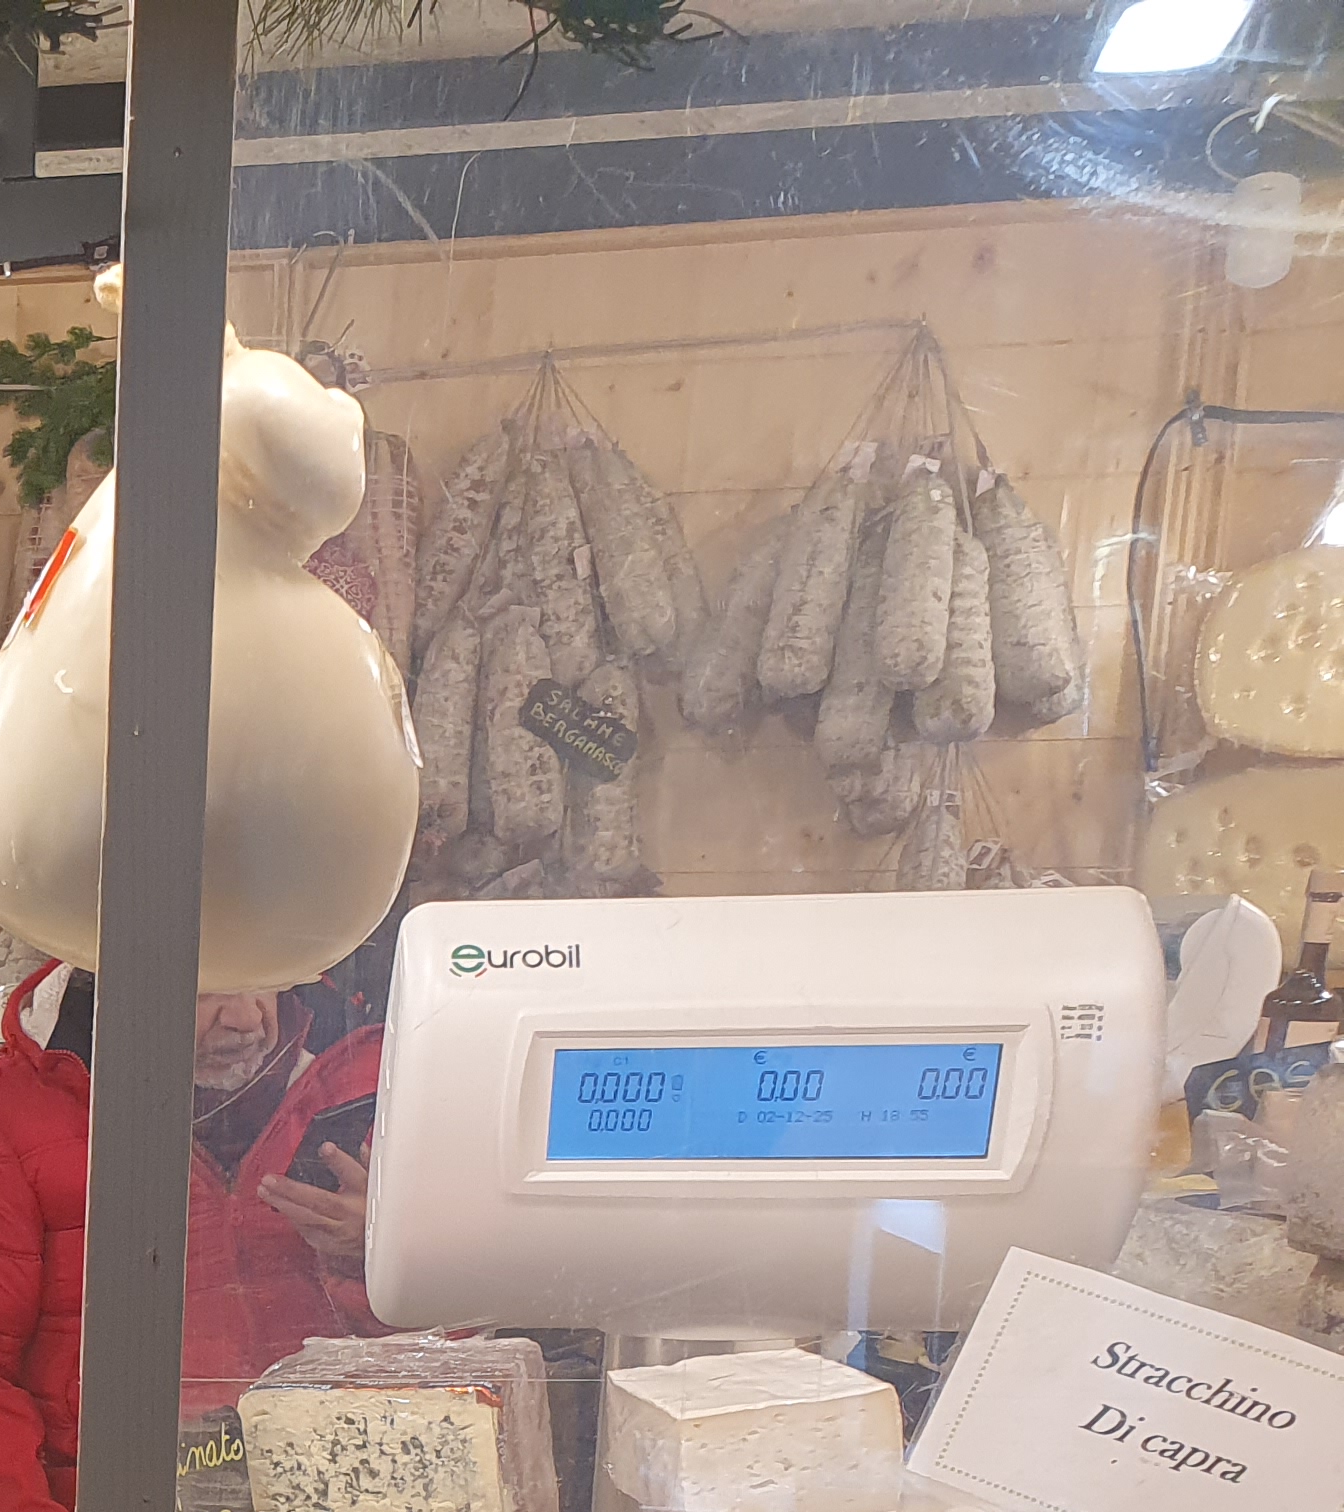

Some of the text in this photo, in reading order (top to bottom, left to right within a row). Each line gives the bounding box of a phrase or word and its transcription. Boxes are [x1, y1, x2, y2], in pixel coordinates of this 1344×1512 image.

[450, 944, 581, 978] eurobil
[1090, 1340, 1297, 1430] Stracchino
[1078, 1403, 1249, 1484] Di capra
